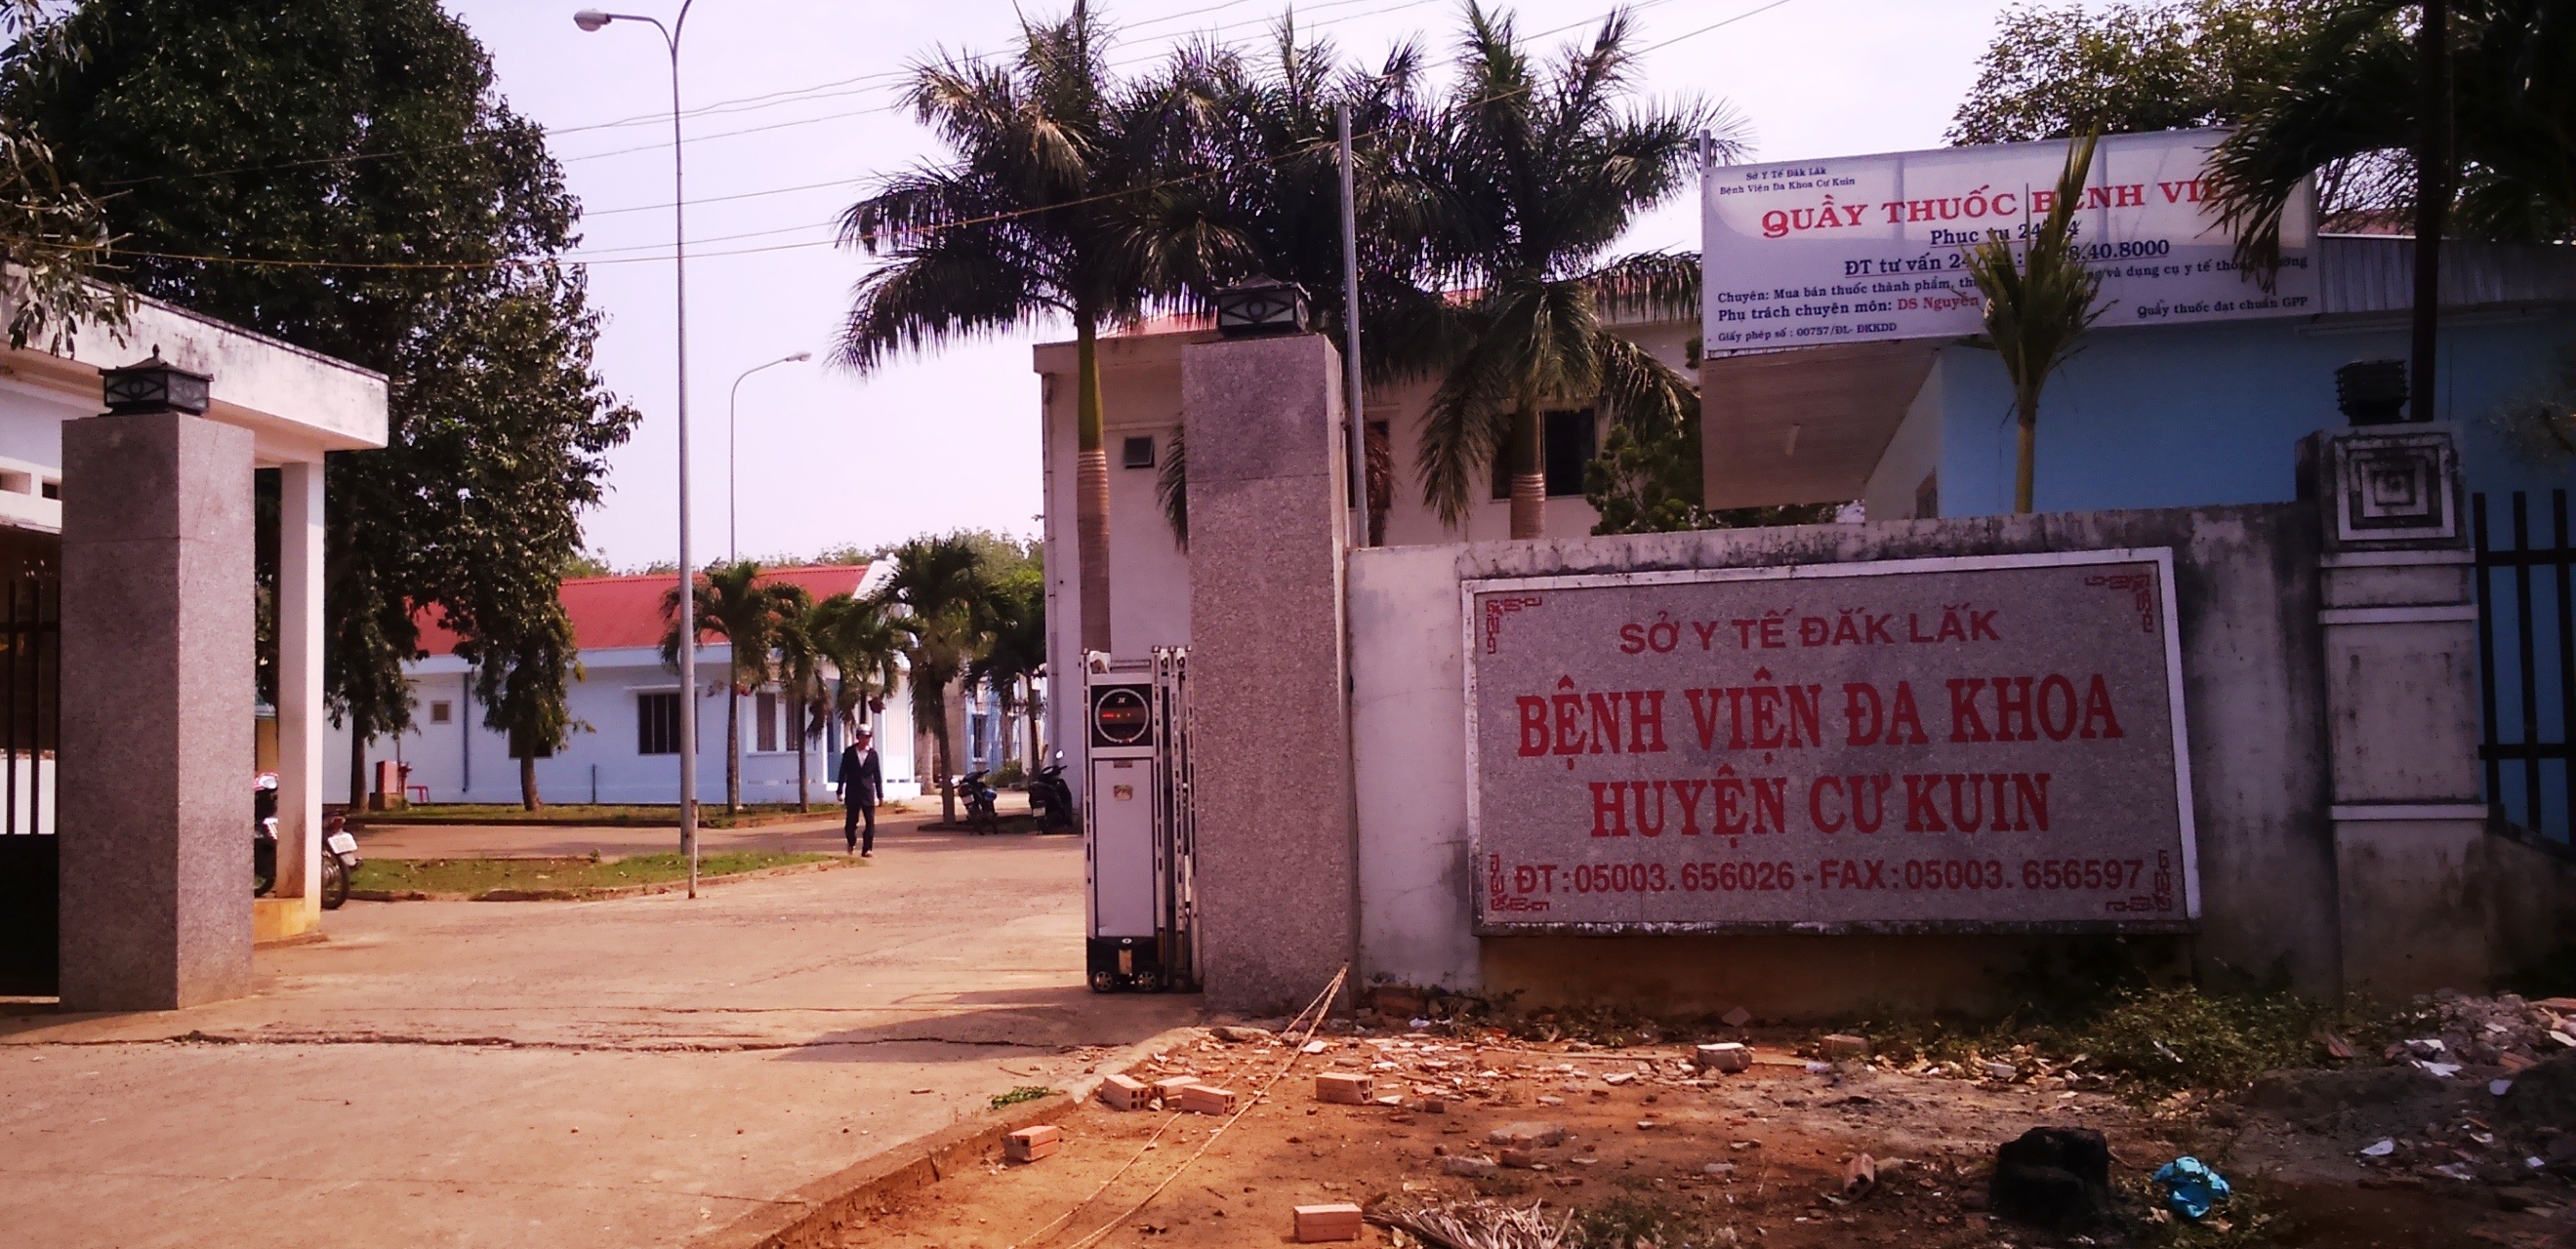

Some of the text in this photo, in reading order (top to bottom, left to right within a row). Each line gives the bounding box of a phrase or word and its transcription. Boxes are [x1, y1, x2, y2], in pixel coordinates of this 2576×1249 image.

[1720, 184, 1744, 196] Bệnh
[1747, 183, 1770, 194] Viện
[1789, 181, 1813, 190] Khoa
[1832, 178, 1856, 186] Kuin
[1761, 171, 1768, 180] Y
[1762, 194, 1868, 238] QUẦY
[1881, 184, 2018, 223] THUỐC
[2032, 183, 2146, 214] BNH
[1845, 259, 1872, 276] ĐT
[1879, 258, 1901, 274] tư
[1906, 252, 1942, 271] vấn
[1718, 291, 1770, 304] Chuyên:
[1774, 289, 1800, 300] Mua
[1804, 286, 1826, 298] bán
[1831, 283, 1867, 296] thuốc
[1872, 280, 1910, 294] thành
[2126, 265, 2159, 279] dụng
[2163, 264, 2180, 276] cụ
[2185, 263, 2192, 276] y
[2197, 259, 2213, 272] tế
[1718, 309, 1745, 324] Phụ
[1751, 305, 1790, 320] trách
[1795, 303, 1849, 318] chuyên
[1855, 300, 1892, 313] môn:
[1898, 299, 1919, 311] DS
[2174, 299, 2209, 314] thuốc
[2214, 301, 2234, 314] đạt
[2239, 295, 2277, 310] chuẩn
[2282, 296, 2309, 307] GPP
[1718, 330, 1742, 342] Giấy
[1745, 328, 1772, 342] phép
[1775, 327, 1787, 339] số
[1619, 601, 2001, 655] SỞ Y TẾ ĐẮK LẮK
[1516, 666, 2124, 771] BỆNH VIỆN ĐA KHOA
[1588, 763, 2051, 849] HUYỆN CƯ KUIN
